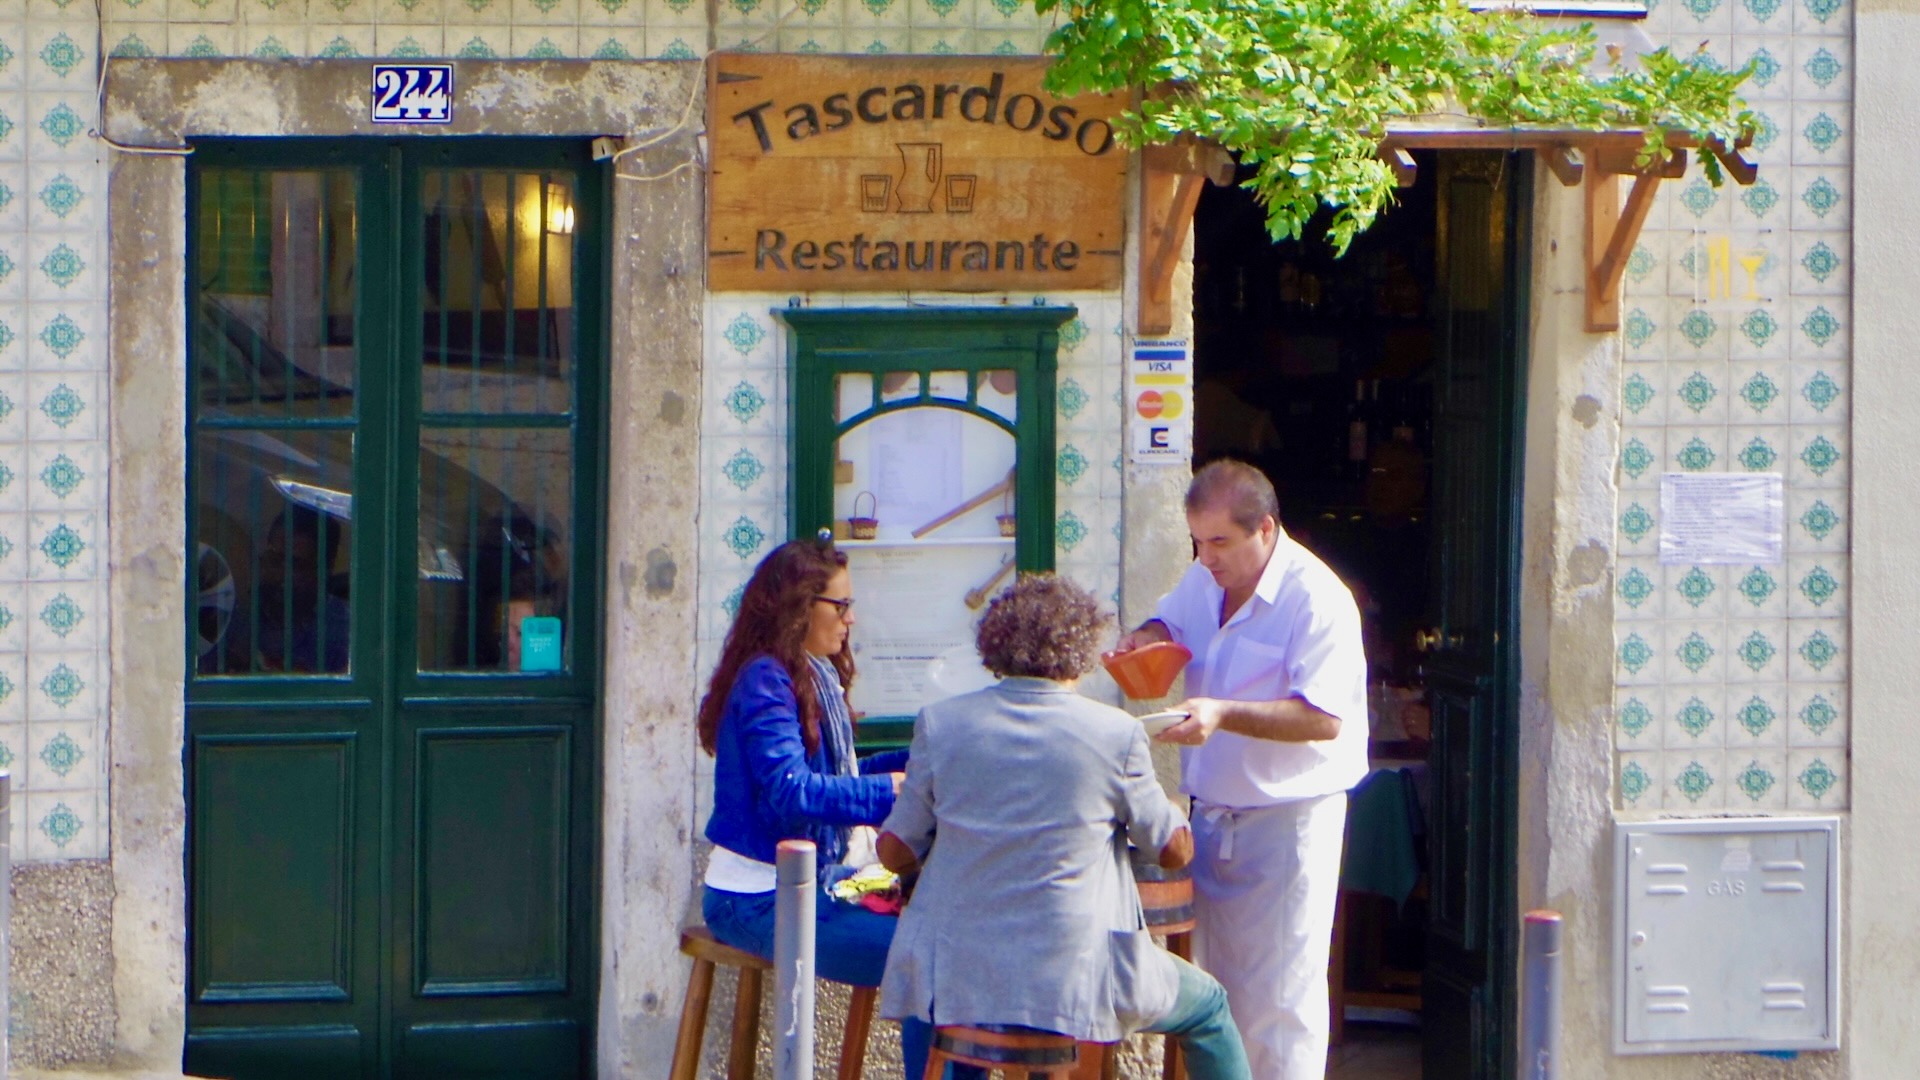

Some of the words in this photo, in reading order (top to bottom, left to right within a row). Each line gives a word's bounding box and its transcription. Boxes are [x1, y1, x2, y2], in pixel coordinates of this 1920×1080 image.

[375, 70, 447, 118] 244
[732, 72, 1115, 156] Tascardoso
[754, 228, 1081, 272] Restaurante
[1149, 362, 1172, 371] VISA
[1707, 879, 1746, 896] GAS
